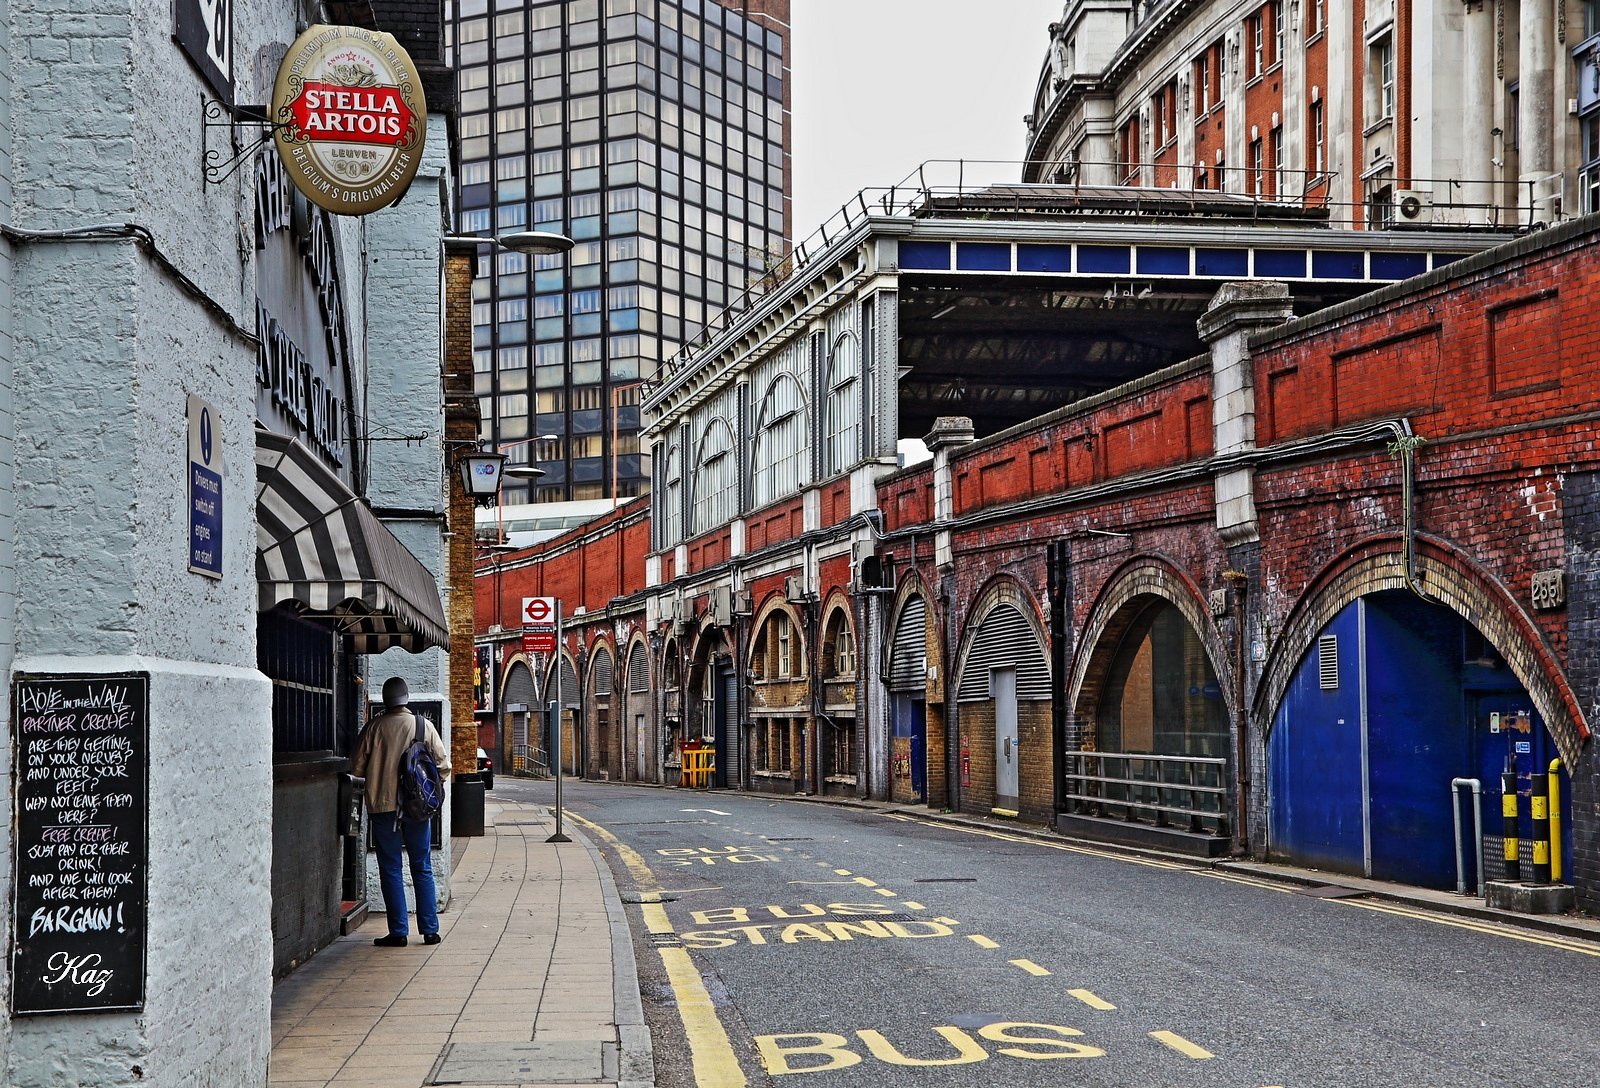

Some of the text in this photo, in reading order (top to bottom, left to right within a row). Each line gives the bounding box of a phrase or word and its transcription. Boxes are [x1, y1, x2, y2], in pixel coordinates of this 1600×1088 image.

[290, 28, 341, 75] PREMIUM
[385, 48, 410, 81] BEER
[327, 53, 346, 67] ANNO
[305, 89, 400, 114] STELLA
[304, 112, 401, 136] ARTOIS
[331, 148, 377, 160] LEUVEN
[292, 146, 411, 203] BELGIUM'S ORIGINAL BEER
[271, 318, 307, 430] THE
[21, 687, 62, 715] HOLE
[73, 698, 90, 708] THE
[88, 684, 130, 713] WALL
[23, 713, 77, 734] PARTNER
[28, 734, 130, 754] ARE THEY GETTING
[28, 753, 44, 766] ON
[49, 751, 79, 766] YOUR
[27, 765, 129, 781] AND UNDER YOUR
[25, 792, 133, 811] WHY NOT LEAVE THEM
[41, 827, 71, 842] FREE
[28, 841, 131, 859] JUST PAY FOR THEIR
[29, 873, 54, 888] AND
[60, 871, 81, 886] WE
[42, 885, 118, 901] AFTER THEM!
[689, 902, 893, 925] BUS
[679, 918, 956, 949] STAND
[753, 1021, 1105, 1076] BUS
